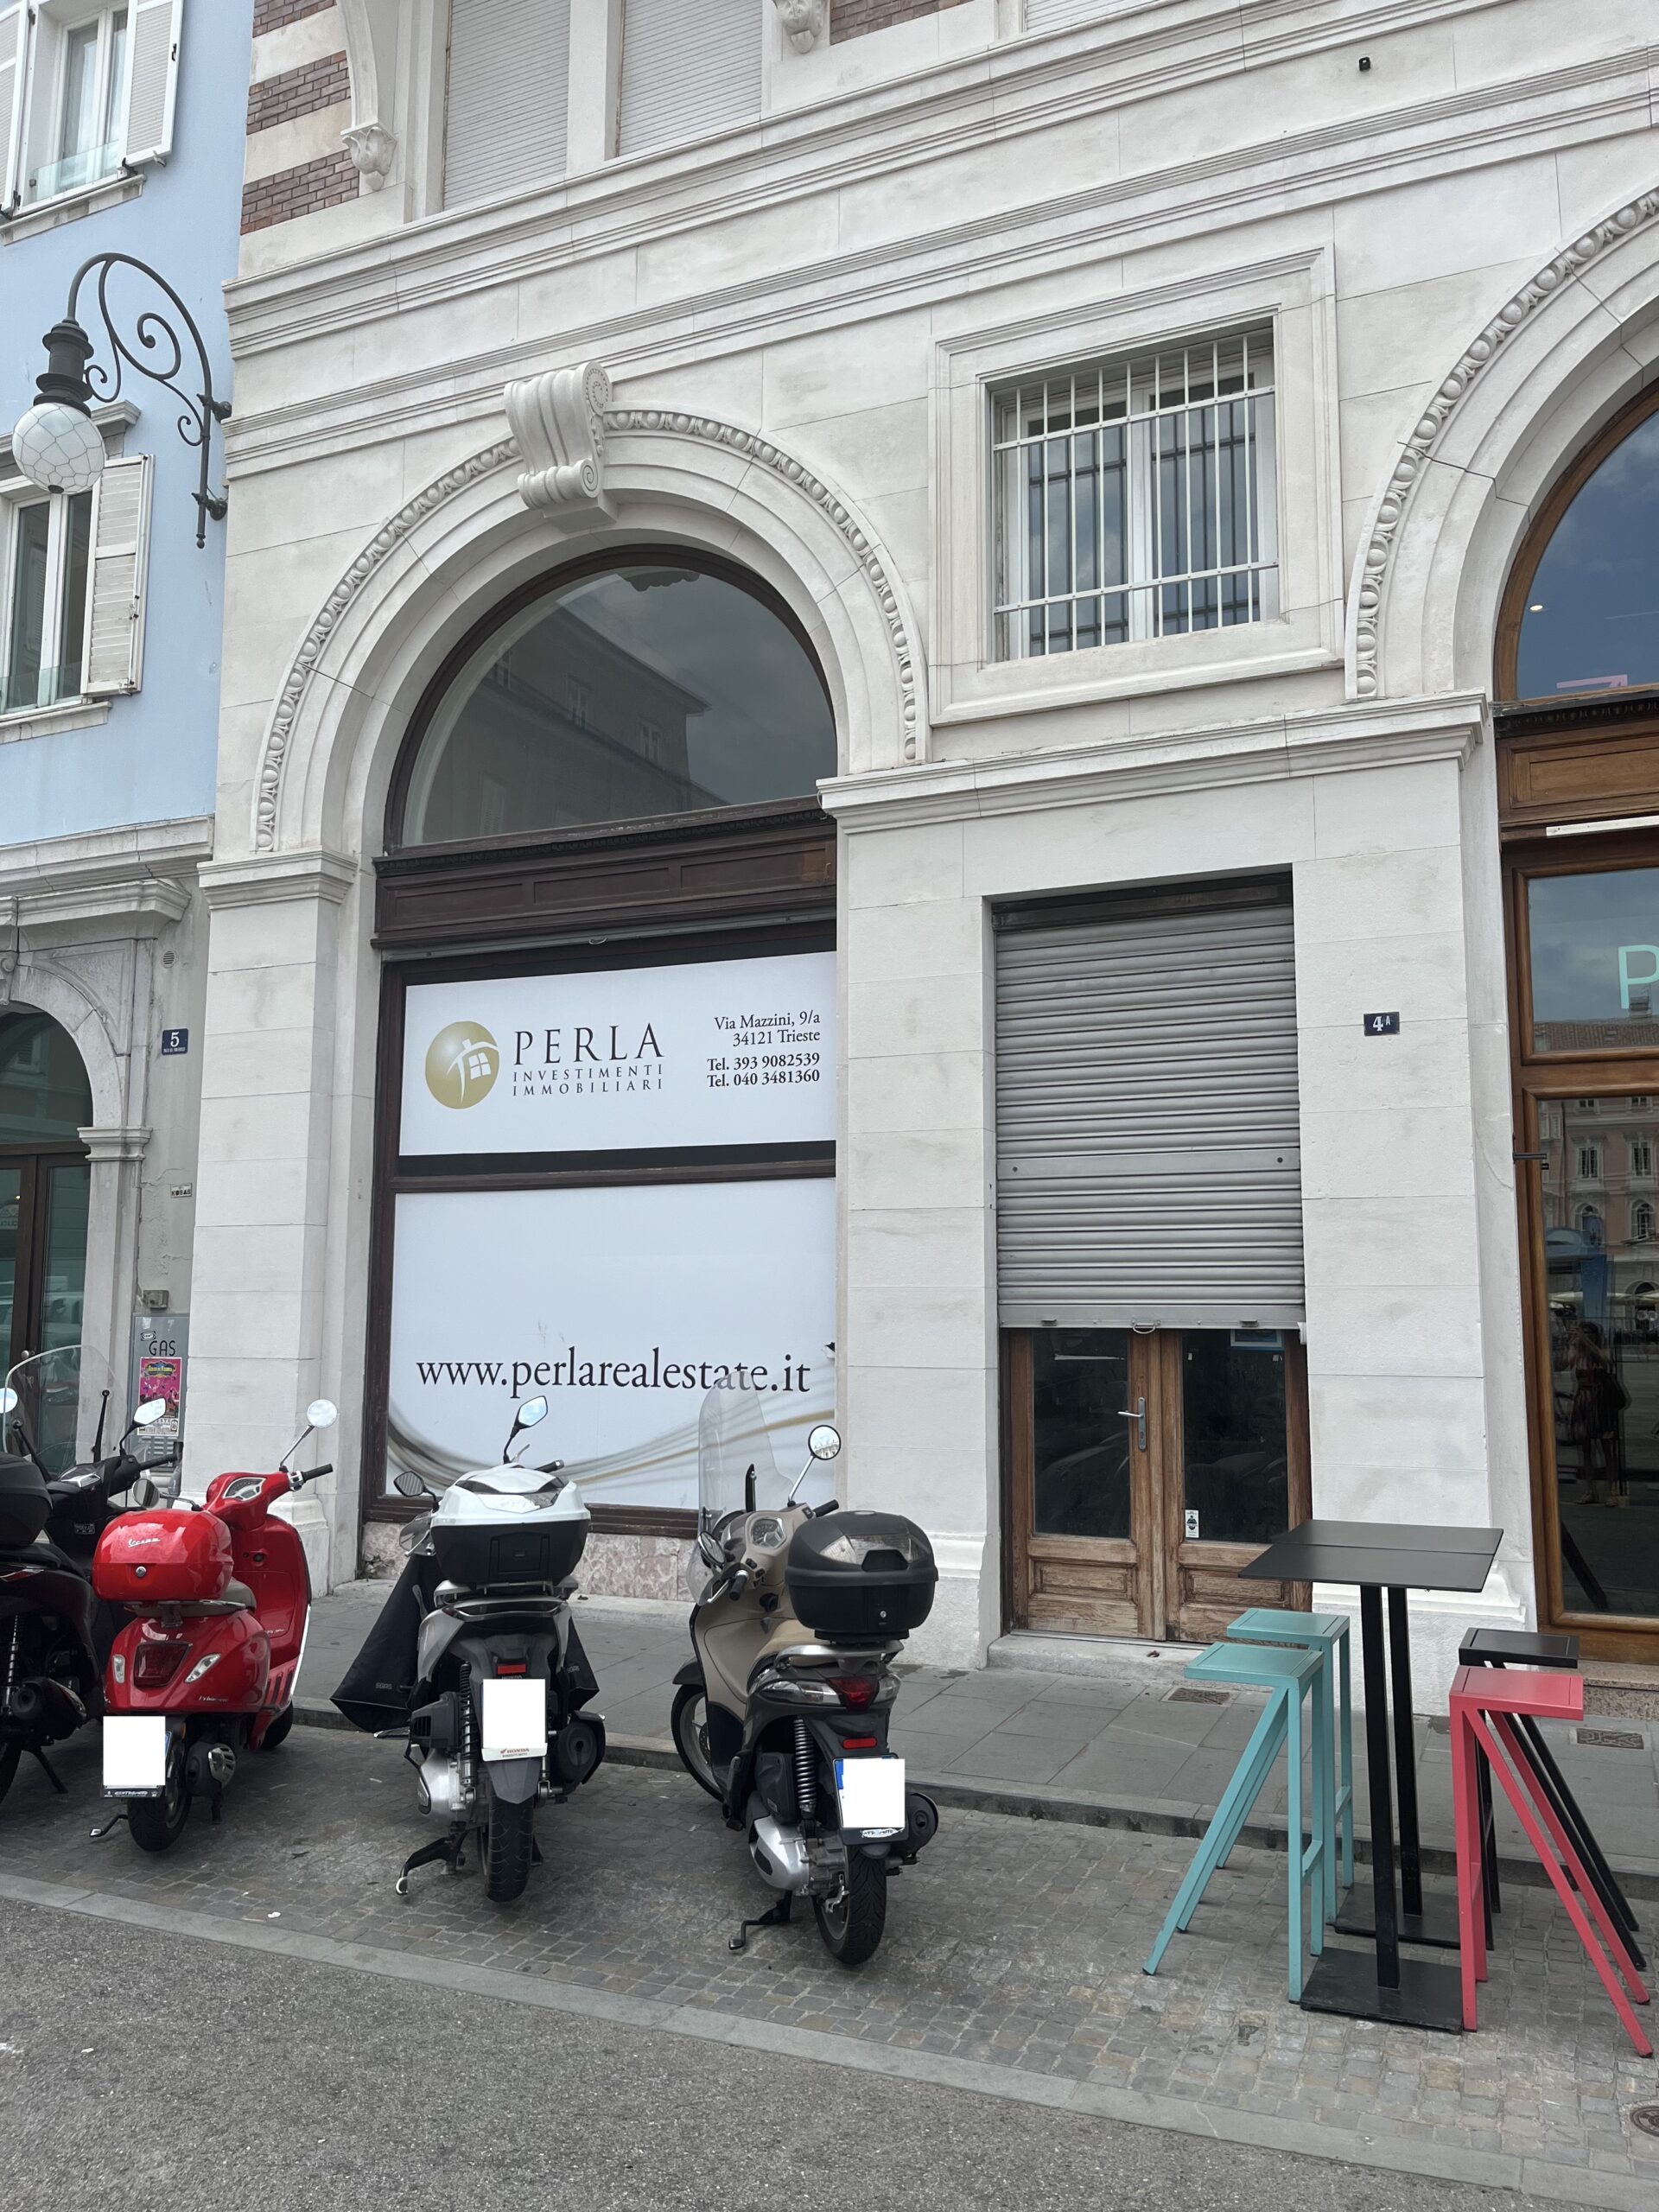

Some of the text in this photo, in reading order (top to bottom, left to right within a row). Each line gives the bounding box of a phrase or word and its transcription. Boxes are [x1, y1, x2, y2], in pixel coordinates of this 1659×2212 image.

[714, 1009, 821, 1030] Via Mazzini, 9/a
[170, 1031, 180, 1047] 5
[514, 1022, 664, 1065] PERLA
[733, 1028, 821, 1046] 34121 Trieste
[707, 1052, 820, 1071] Tel. 393 9082539
[513, 1064, 663, 1082] INVESTIMENTI
[706, 1068, 820, 1088] Tel. 040 3481360
[513, 1078, 663, 1096] IMMOBILIARI
[149, 1340, 175, 1357] GAS
[416, 1345, 811, 1399] www.perlarealestate.it
